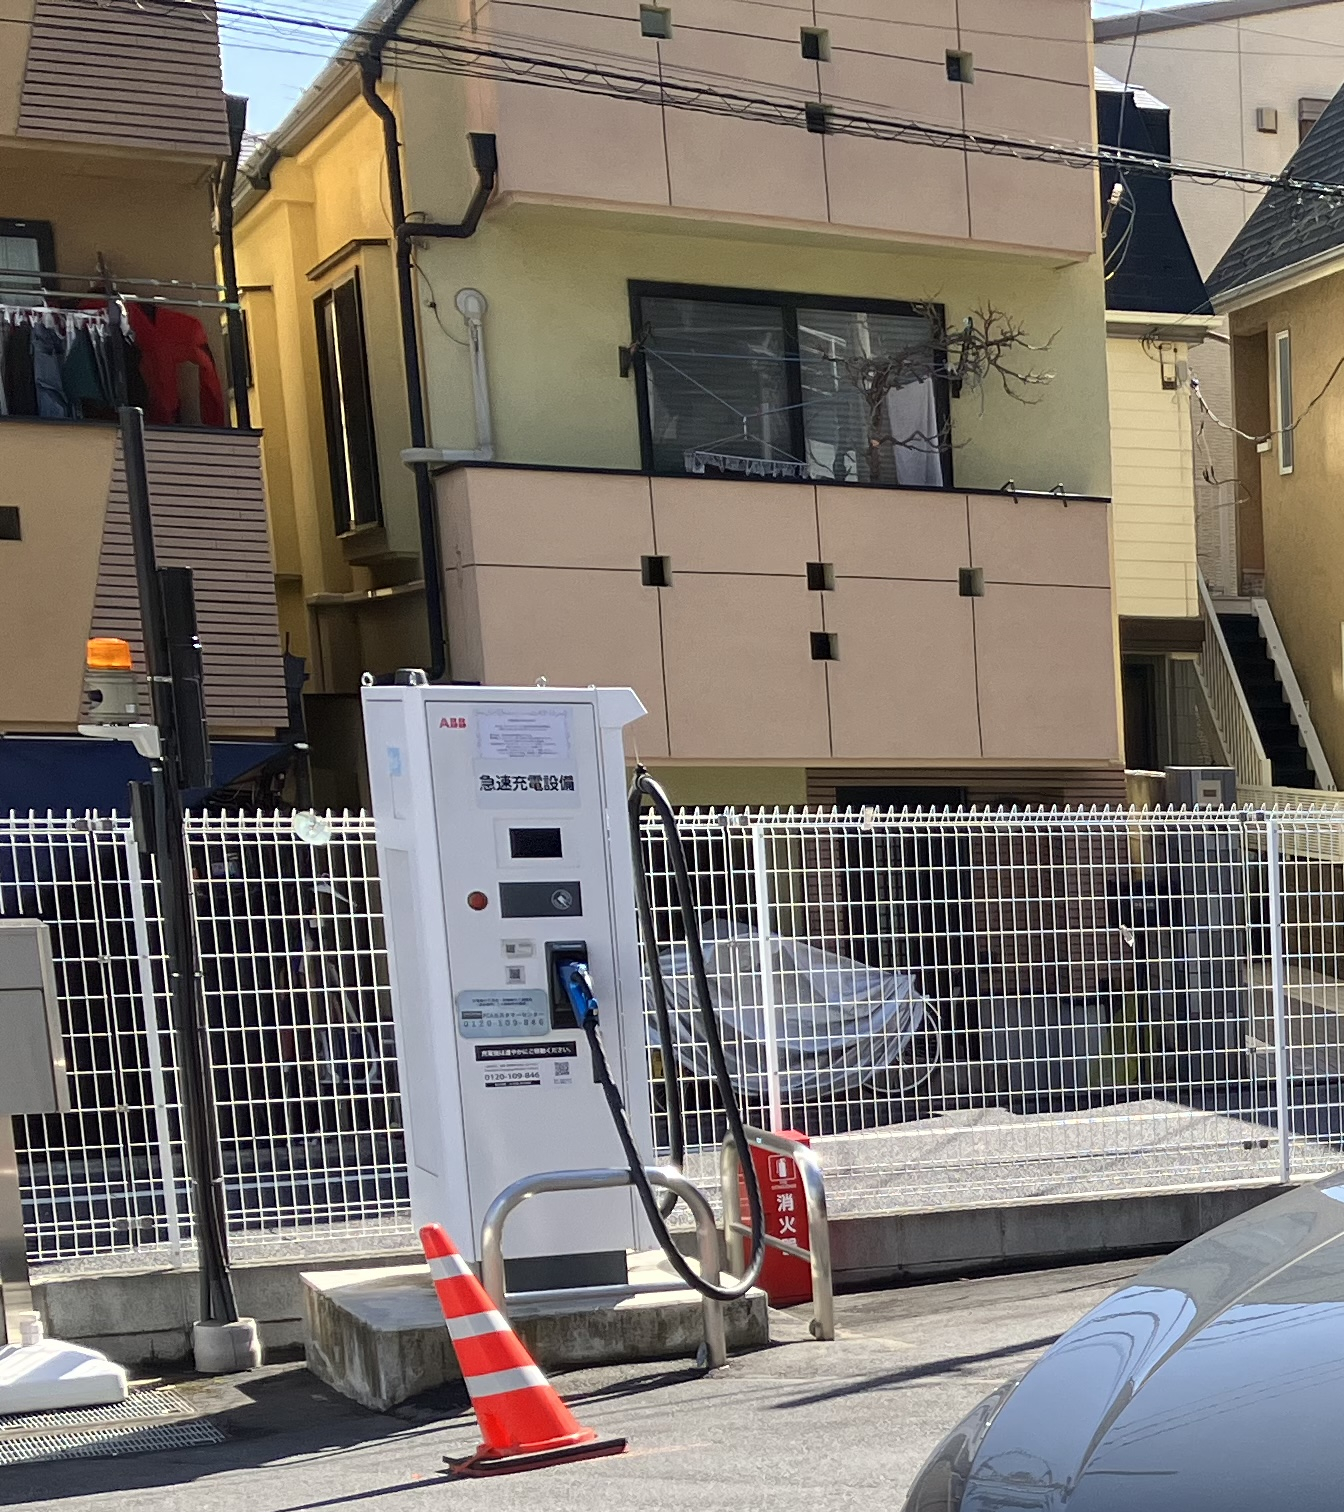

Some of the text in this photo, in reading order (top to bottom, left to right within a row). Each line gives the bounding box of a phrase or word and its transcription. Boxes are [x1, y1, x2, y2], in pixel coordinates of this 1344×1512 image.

[439, 717, 467, 729] ABB
[479, 774, 576, 792] 急速充電設備
[484, 1071, 541, 1081] 0120-109-846
